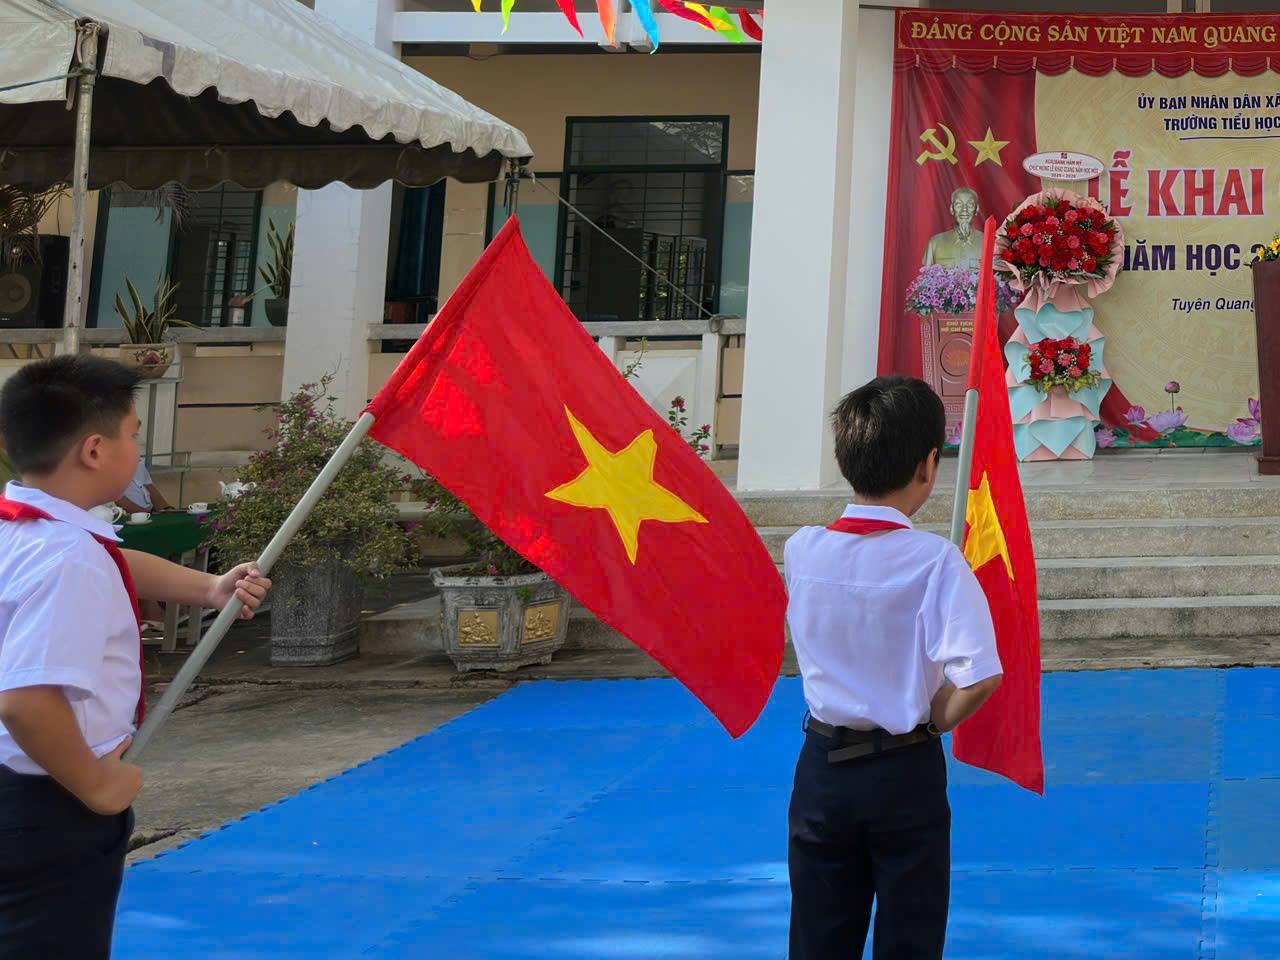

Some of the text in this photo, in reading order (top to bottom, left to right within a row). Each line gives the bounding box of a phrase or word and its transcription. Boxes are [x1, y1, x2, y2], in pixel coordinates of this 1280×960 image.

[911, 16, 973, 40] ĐẢNG
[980, 20, 1040, 45] CỘNG
[1048, 19, 1088, 41] SẢN
[1094, 22, 1144, 48] VIỆT
[1151, 26, 1197, 43] NAM
[1203, 25, 1277, 48] QUANG
[1138, 93, 1155, 109] ỦY
[1159, 96, 1187, 109] BAN
[1191, 94, 1229, 109] NHÂN
[1233, 93, 1261, 109] DÂN
[1164, 114, 1217, 131] TRƯỜNG
[1221, 113, 1250, 130] TIỂU
[1147, 168, 1266, 216] KHAI
[1186, 243, 1240, 276] HỌC
[1172, 297, 1210, 313] Tuyên
